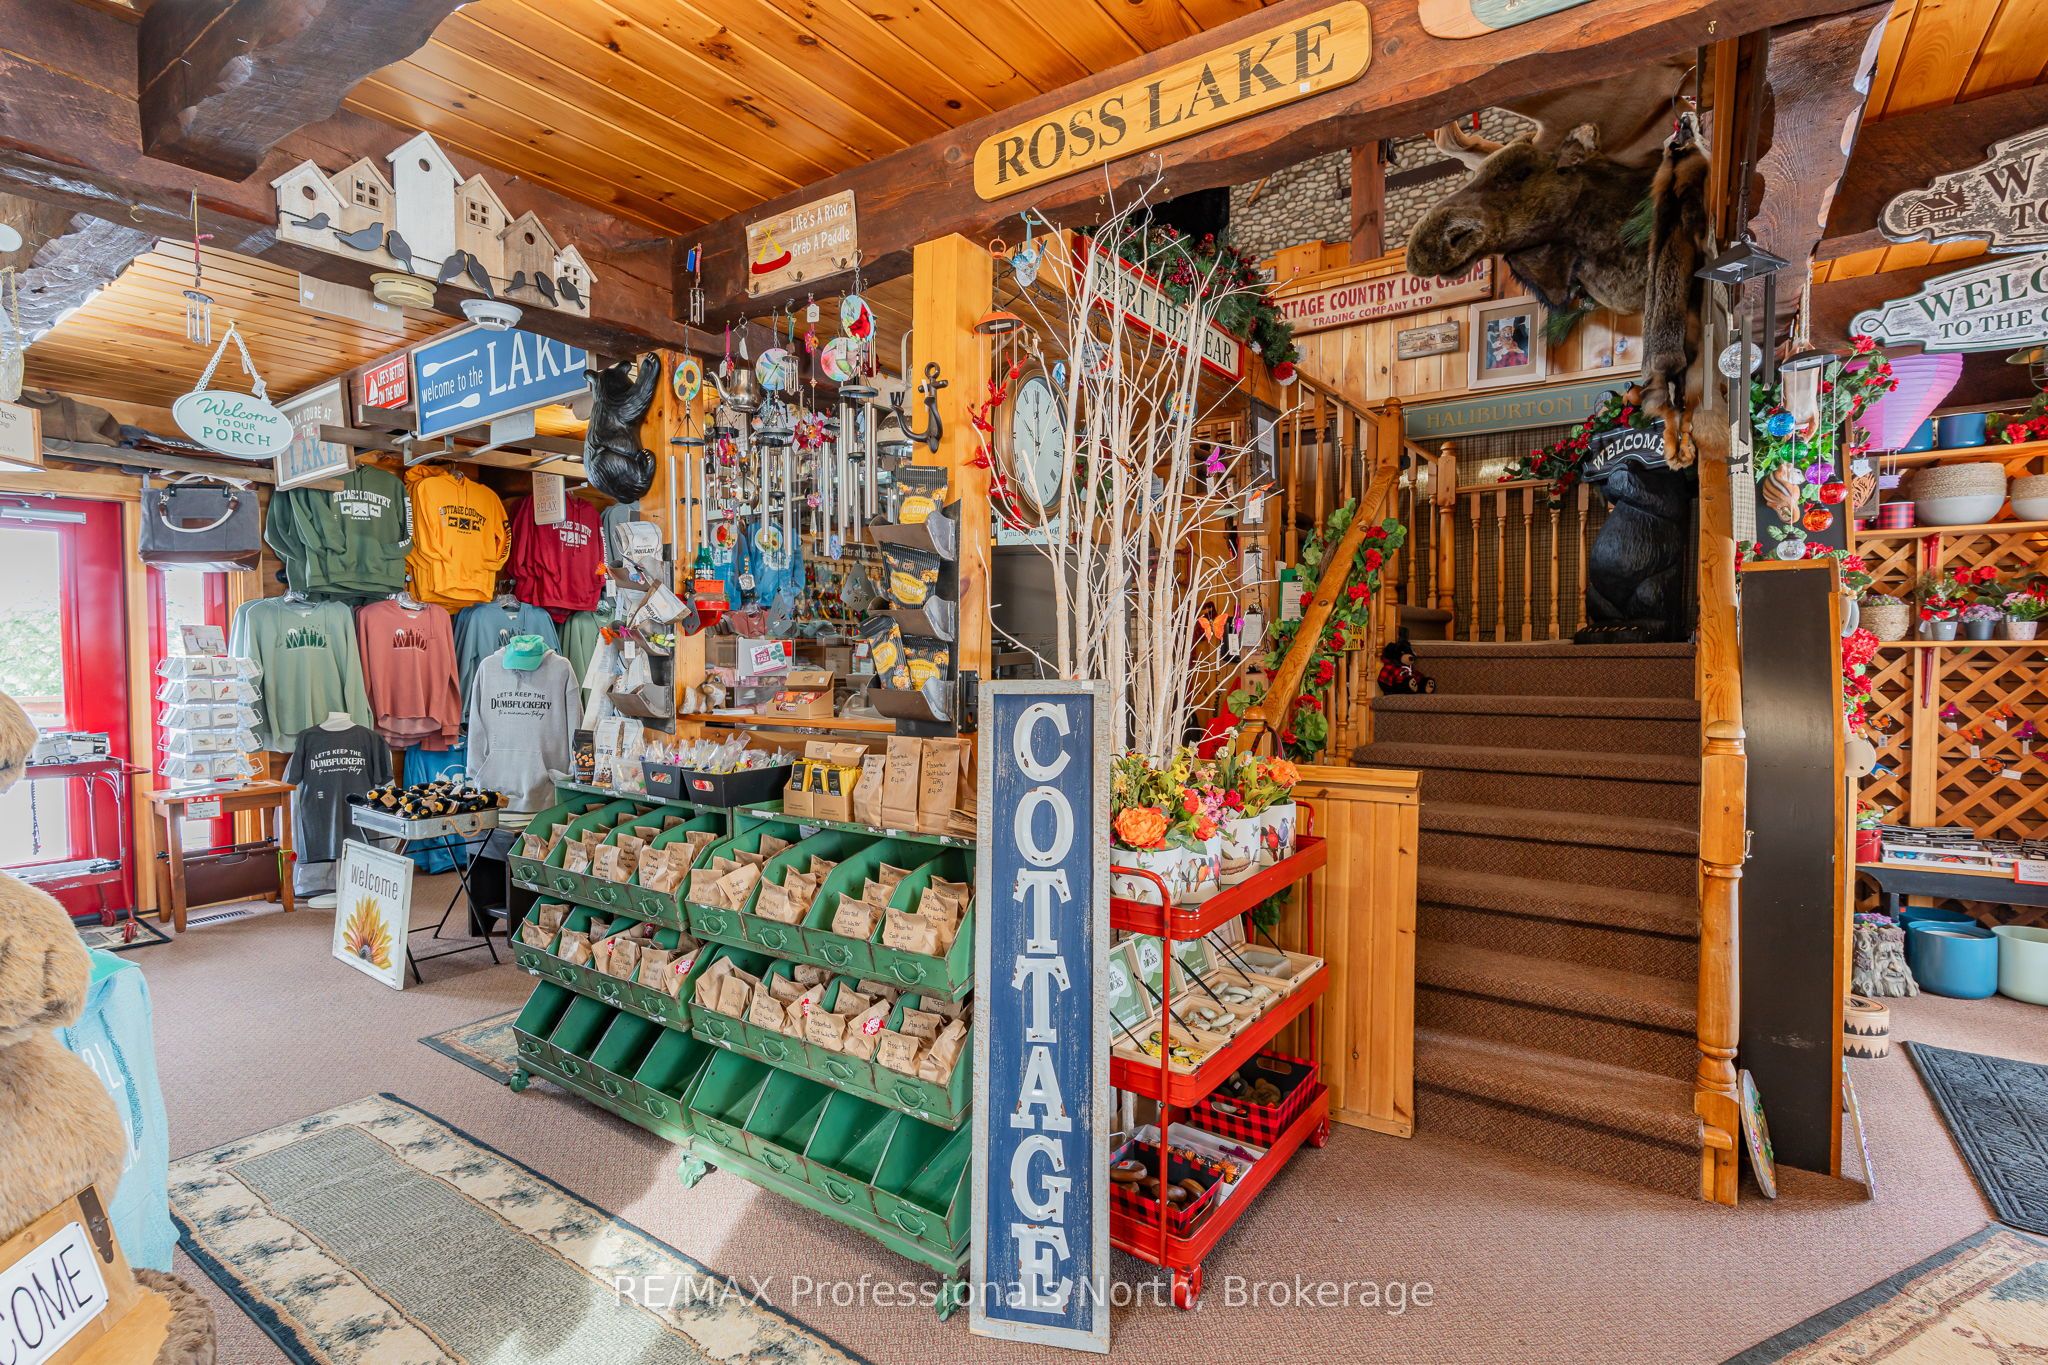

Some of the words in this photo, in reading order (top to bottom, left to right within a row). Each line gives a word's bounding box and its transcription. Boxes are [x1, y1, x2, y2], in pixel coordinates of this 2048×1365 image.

[994, 96, 1127, 186] ROSS
[1145, 18, 1335, 134] LAKE
[817, 207, 823, 225] A
[824, 201, 848, 222] River
[792, 240, 811, 257] Grab
[813, 235, 819, 251] A
[821, 225, 850, 249] Paddle
[1330, 279, 1396, 311] COUNTRY
[1402, 275, 1431, 296] LOG
[1312, 310, 1355, 327] TRADING
[1359, 300, 1409, 318] COMPANY
[1412, 295, 1434, 307] LTD
[1939, 320, 1973, 340] TO
[1978, 309, 2033, 333] THE
[1194, 320, 1232, 371] EAR
[385, 385, 394, 402] THE
[393, 381, 406, 400] BOAT
[421, 376, 456, 404] welcome
[457, 373, 467, 393] to
[468, 365, 484, 388] the
[196, 397, 278, 424] Welcome
[215, 417, 231, 427] TO
[232, 420, 257, 431] OUR
[323, 406, 333, 422] AT
[1426, 394, 1574, 431] HALIBURTON
[202, 426, 271, 447] PORCH
[1592, 432, 1665, 471] WELCOME
[491, 698, 552, 710] DUMBFUCKERY
[496, 691, 513, 699] LET'S
[315, 750, 331, 760] LET'S
[349, 749, 362, 757] THE
[187, 795, 221, 804] SALE
[351, 863, 399, 901] welcome
[1010, 702, 1074, 1314] COTTAGE
